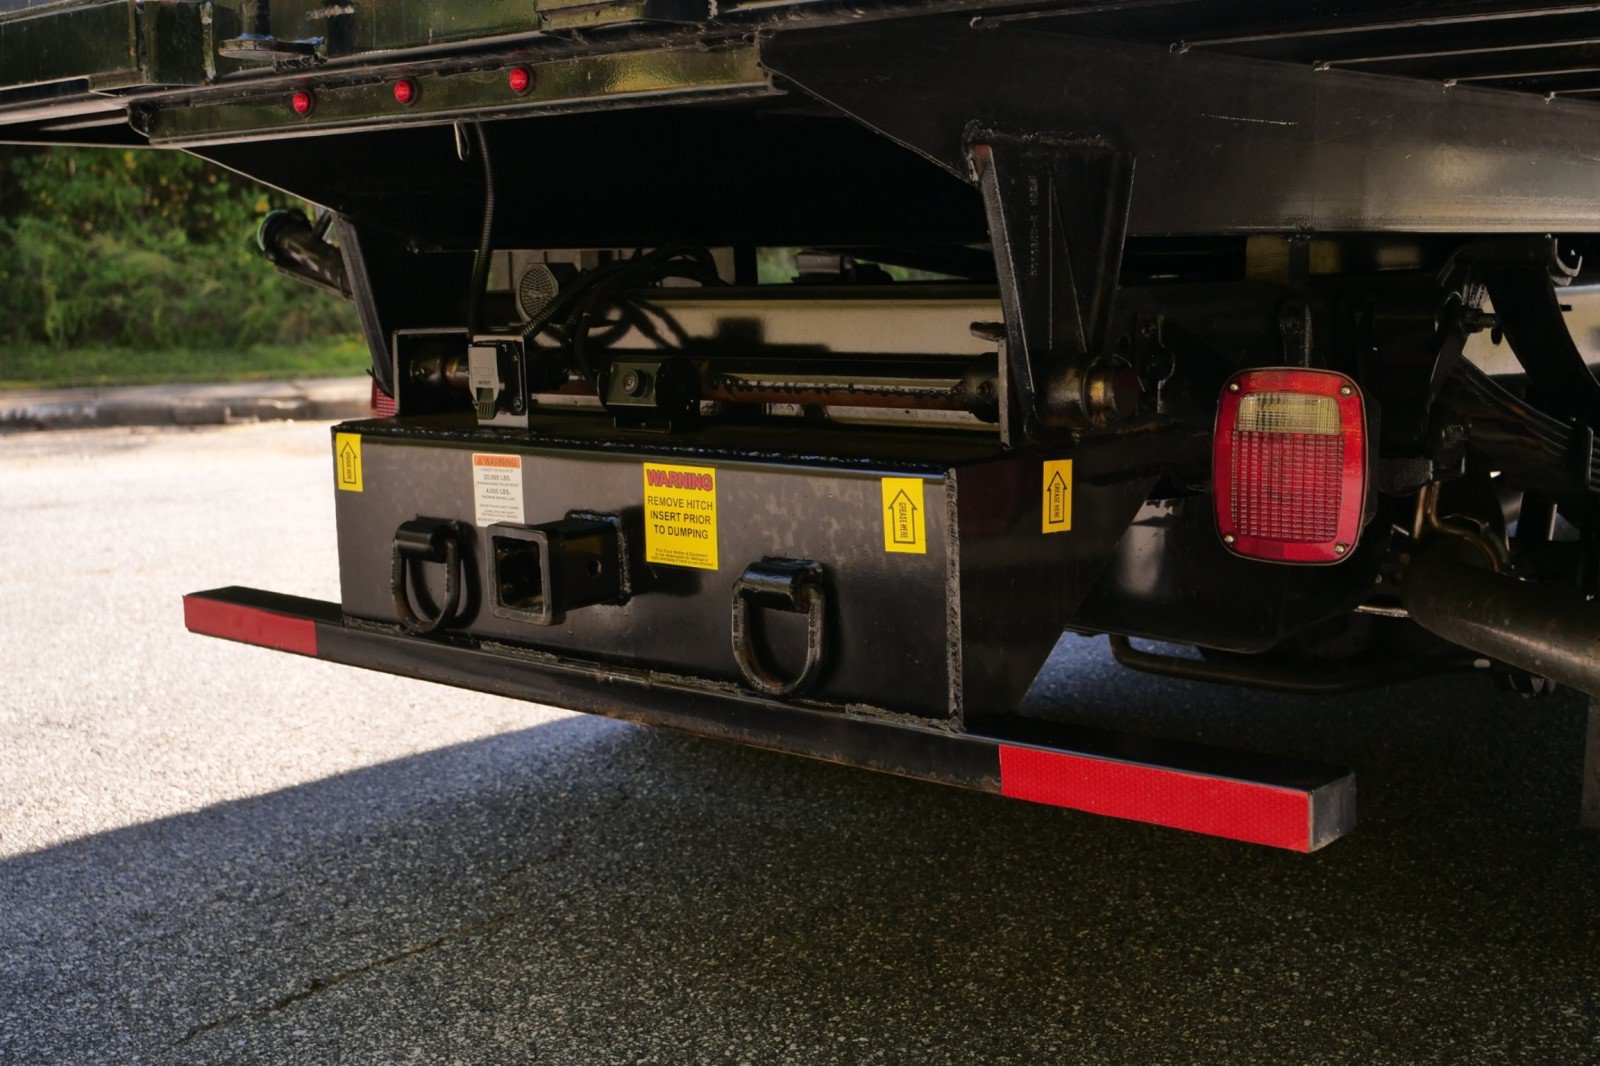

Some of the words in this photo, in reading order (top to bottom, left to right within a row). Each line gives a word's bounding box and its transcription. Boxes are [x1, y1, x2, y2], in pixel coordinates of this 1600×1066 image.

[483, 456, 518, 467] WARNING
[646, 469, 713, 491] WARNING
[647, 495, 684, 508] REMOVE
[686, 499, 713, 511] HITCH
[650, 510, 681, 522] INSERT
[683, 513, 711, 525] PRIOR
[899, 502, 907, 523] GREASE
[654, 524, 665, 535] TO
[667, 526, 709, 540] DUMPING
[900, 524, 908, 539] HERE
